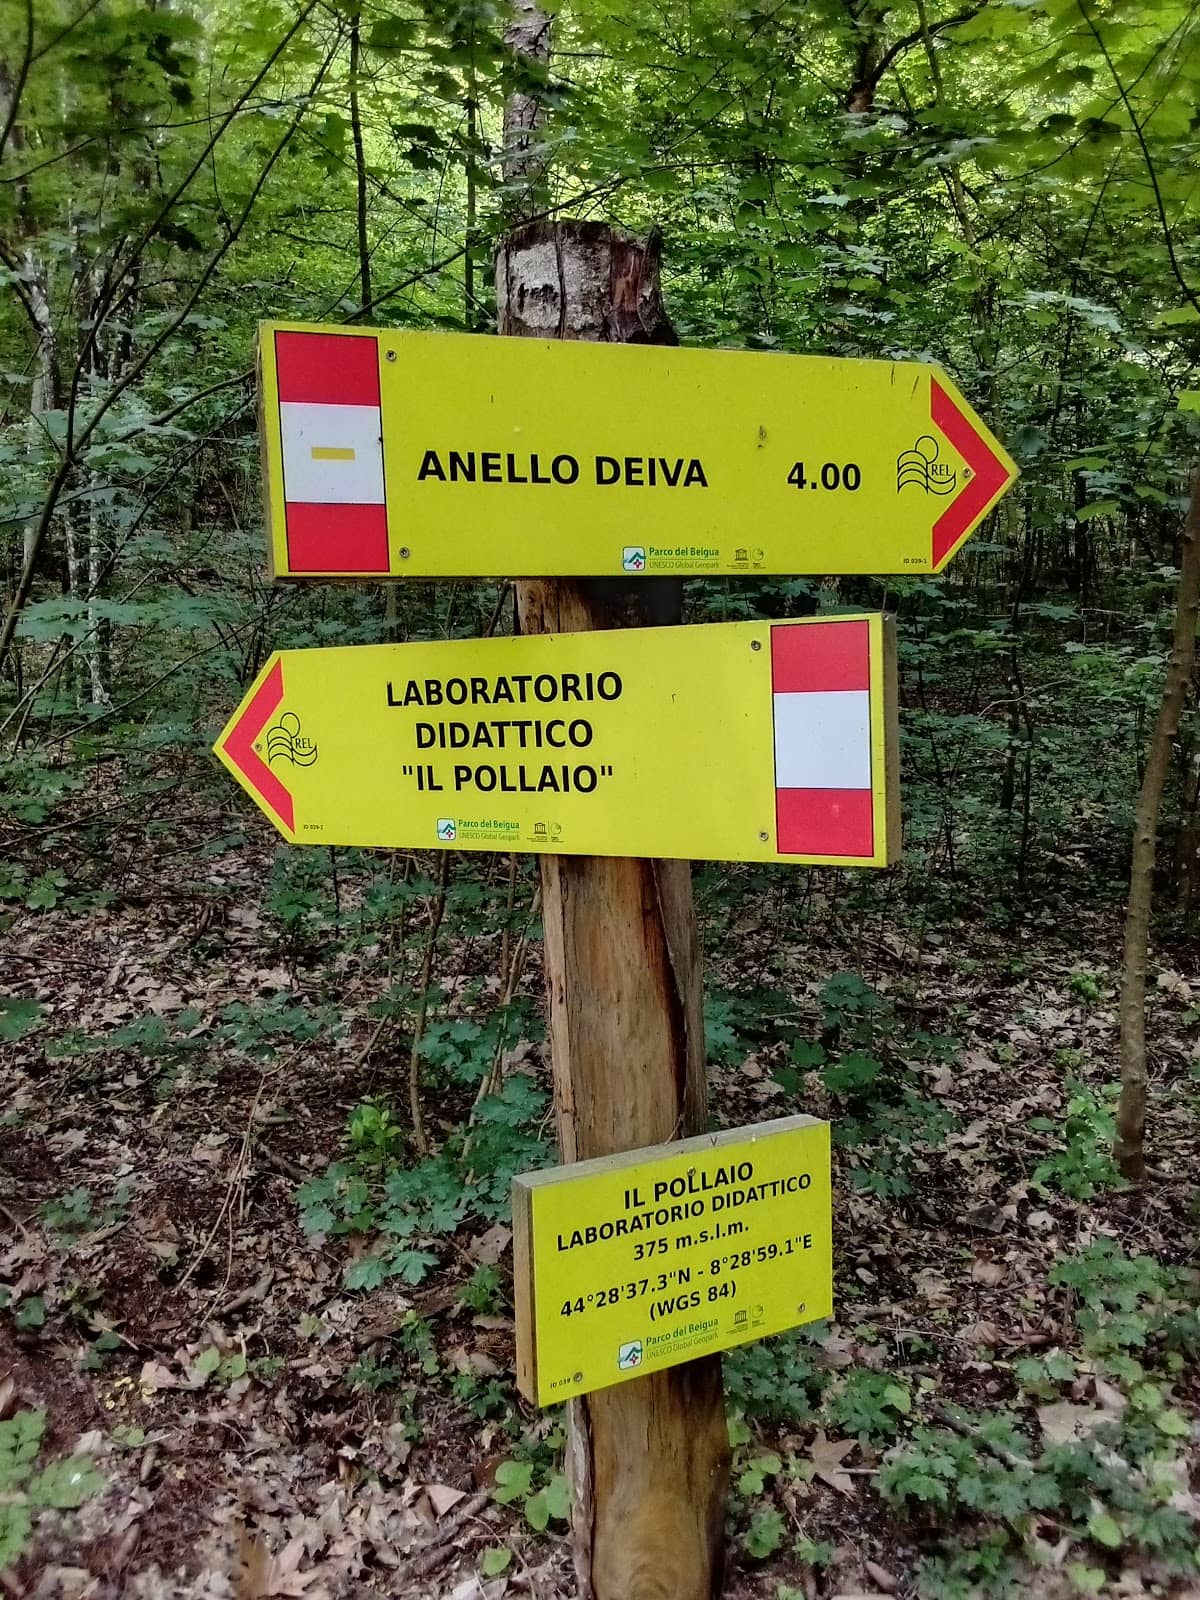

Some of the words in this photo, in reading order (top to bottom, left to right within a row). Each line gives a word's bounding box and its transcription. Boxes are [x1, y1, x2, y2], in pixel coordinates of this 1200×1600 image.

[417, 450, 580, 485] ANELLO
[595, 456, 708, 488] DEIVA
[787, 462, 861, 491] 4.00
[931, 463, 951, 476] REL
[649, 547, 673, 556] Parco
[674, 547, 688, 556] del
[690, 548, 720, 559] Beigua
[650, 560, 675, 569] UNESCO
[675, 560, 694, 569] Global
[694, 560, 720, 570] Geopark
[386, 671, 622, 707] LABORATORIO
[295, 738, 313, 749] REL
[416, 719, 593, 749] DIDATTICO
[402, 765, 443, 791] "IL
[454, 765, 613, 793] POLLAIO"
[458, 819, 479, 828] Parco
[480, 820, 492, 829] del
[493, 821, 520, 831] Beigua
[624, 1189, 646, 1209] IL
[654, 1162, 753, 1202] POLLAIO
[557, 1200, 705, 1251] LABORATORIO
[711, 1173, 811, 1211] DIDATTICO
[633, 1238, 668, 1261] 375
[676, 1221, 749, 1250] m.s.l.m.
[649, 1291, 701, 1321] (WGS
[708, 1280, 737, 1302] 84)
[646, 1333, 671, 1346] Parco
[672, 1328, 687, 1338] del
[689, 1318, 719, 1332] Beigua
[646, 1346, 673, 1360] UNESCO
[673, 1339, 692, 1351] Global
[693, 1332, 719, 1346] Geopark
